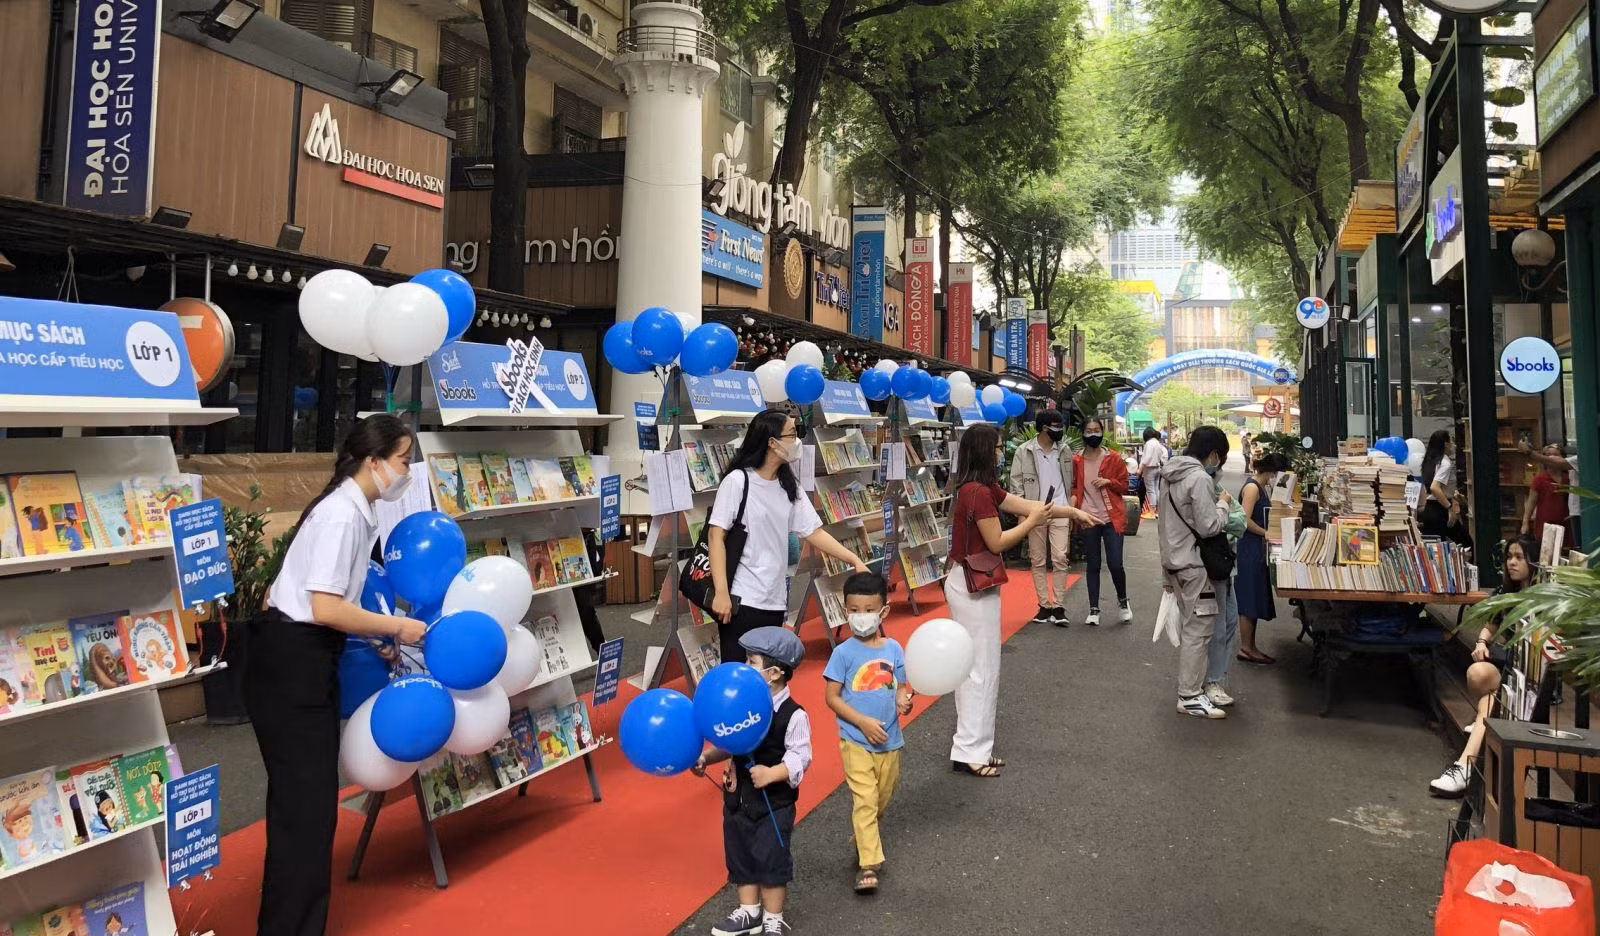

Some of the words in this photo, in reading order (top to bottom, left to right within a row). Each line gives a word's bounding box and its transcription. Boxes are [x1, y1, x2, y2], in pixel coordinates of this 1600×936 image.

[92, 0, 114, 50] HO
[88, 59, 114, 128] HỌC
[115, 74, 134, 126] SEN
[84, 139, 110, 197] ĐẠI
[110, 133, 131, 194] HOA
[395, 165, 422, 187] HOA
[423, 175, 445, 194] SEN
[720, 228, 741, 257] First
[740, 236, 765, 265] News
[37, 320, 86, 346] SÁCH
[7, 352, 38, 367] HỌC
[98, 357, 125, 372] HỌC
[132, 341, 161, 361] LỚP
[165, 347, 173, 362] 1
[530, 340, 543, 363] SINH
[1506, 356, 1555, 372] Sbooks
[502, 343, 528, 394] Sbooks
[439, 379, 477, 400] Sbooks
[191, 537, 206, 551] LỚP
[207, 537, 212, 546] 1
[184, 569, 206, 585] ĐẠO
[207, 560, 228, 577] ĐỨC
[714, 710, 761, 737] Sbooks
[183, 808, 198, 824] LỚP
[200, 807, 204, 817] 1
[171, 844, 193, 861] HOẠT
[194, 833, 217, 851] ĐỘNG
[186, 827, 202, 840] MÔN
[171, 857, 188, 874] TRẢI
[189, 845, 218, 867] NGHIỆM
